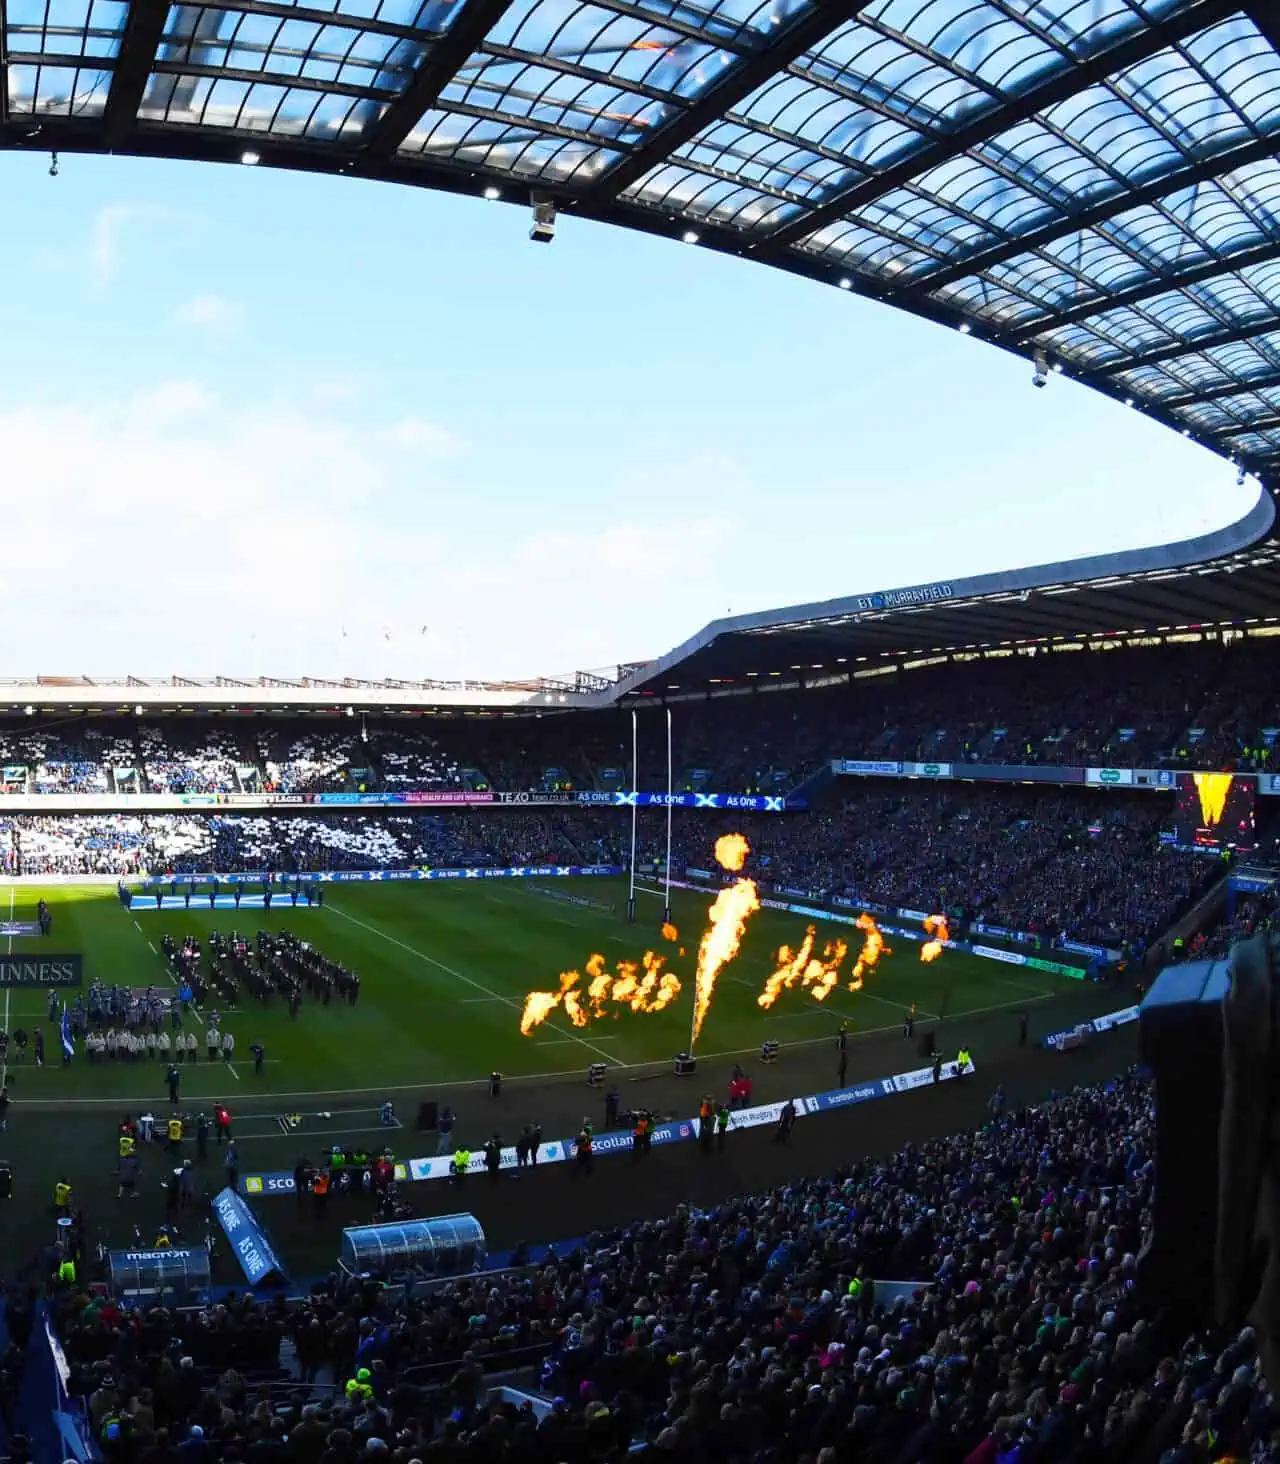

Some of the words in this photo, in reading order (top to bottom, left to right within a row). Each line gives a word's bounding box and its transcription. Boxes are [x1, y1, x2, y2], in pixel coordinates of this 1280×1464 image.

[857, 598, 872, 609] BT
[885, 585, 952, 605] MURRAYFIELD
[649, 794, 662, 803] As
[668, 795, 685, 804] One
[726, 797, 738, 806] As
[740, 797, 757, 807] One
[827, 1092, 855, 1105] Scottish
[855, 1086, 875, 1099] Rugby
[749, 1112, 774, 1123] Rugby
[216, 1199, 231, 1214] AS
[223, 1209, 241, 1232] ONE
[238, 1236, 253, 1254] AS
[126, 1250, 191, 1261] macron
[245, 1249, 265, 1275] ONE
